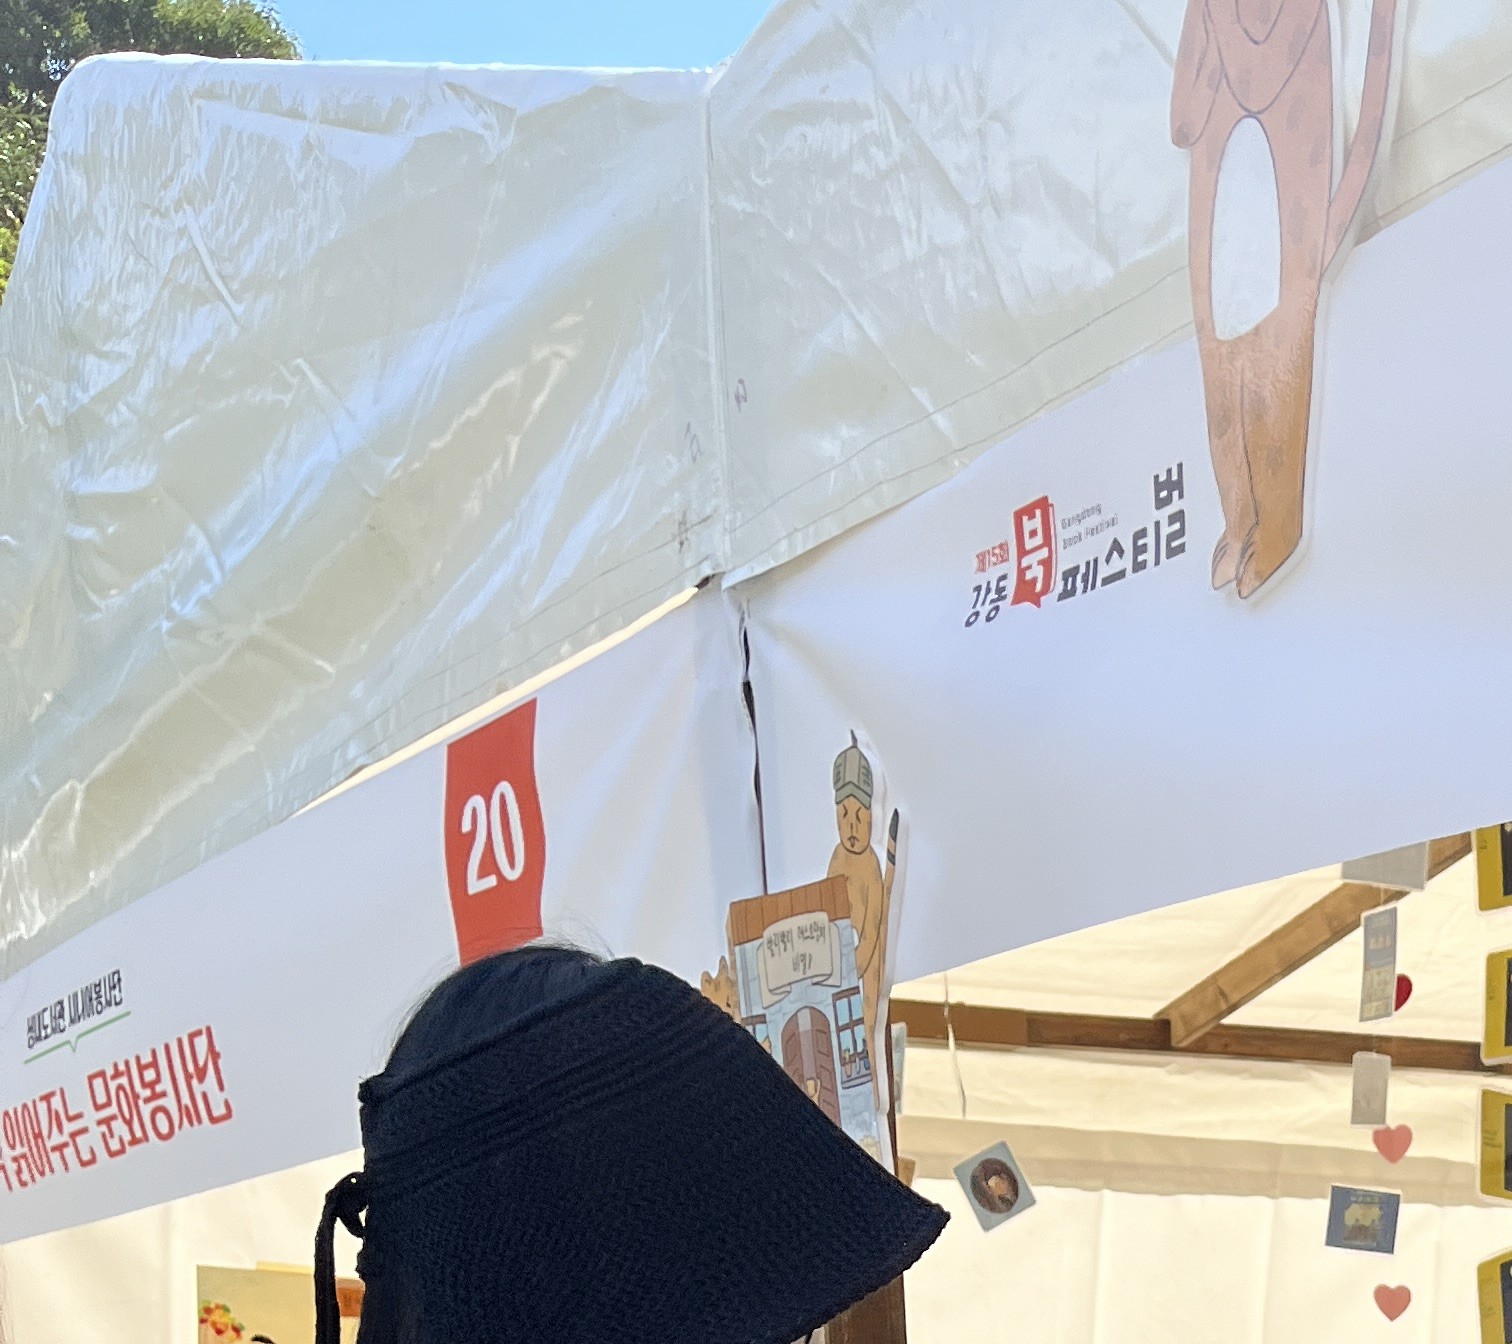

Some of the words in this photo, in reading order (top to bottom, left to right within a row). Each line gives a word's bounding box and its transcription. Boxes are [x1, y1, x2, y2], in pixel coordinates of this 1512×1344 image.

[964, 573, 1009, 628] 강동
[1056, 461, 1187, 603] 페스티벌
[460, 779, 527, 896] 20
[2, 1086, 98, 1189] 읽어주는
[86, 1024, 233, 1158] 문화봉사단
